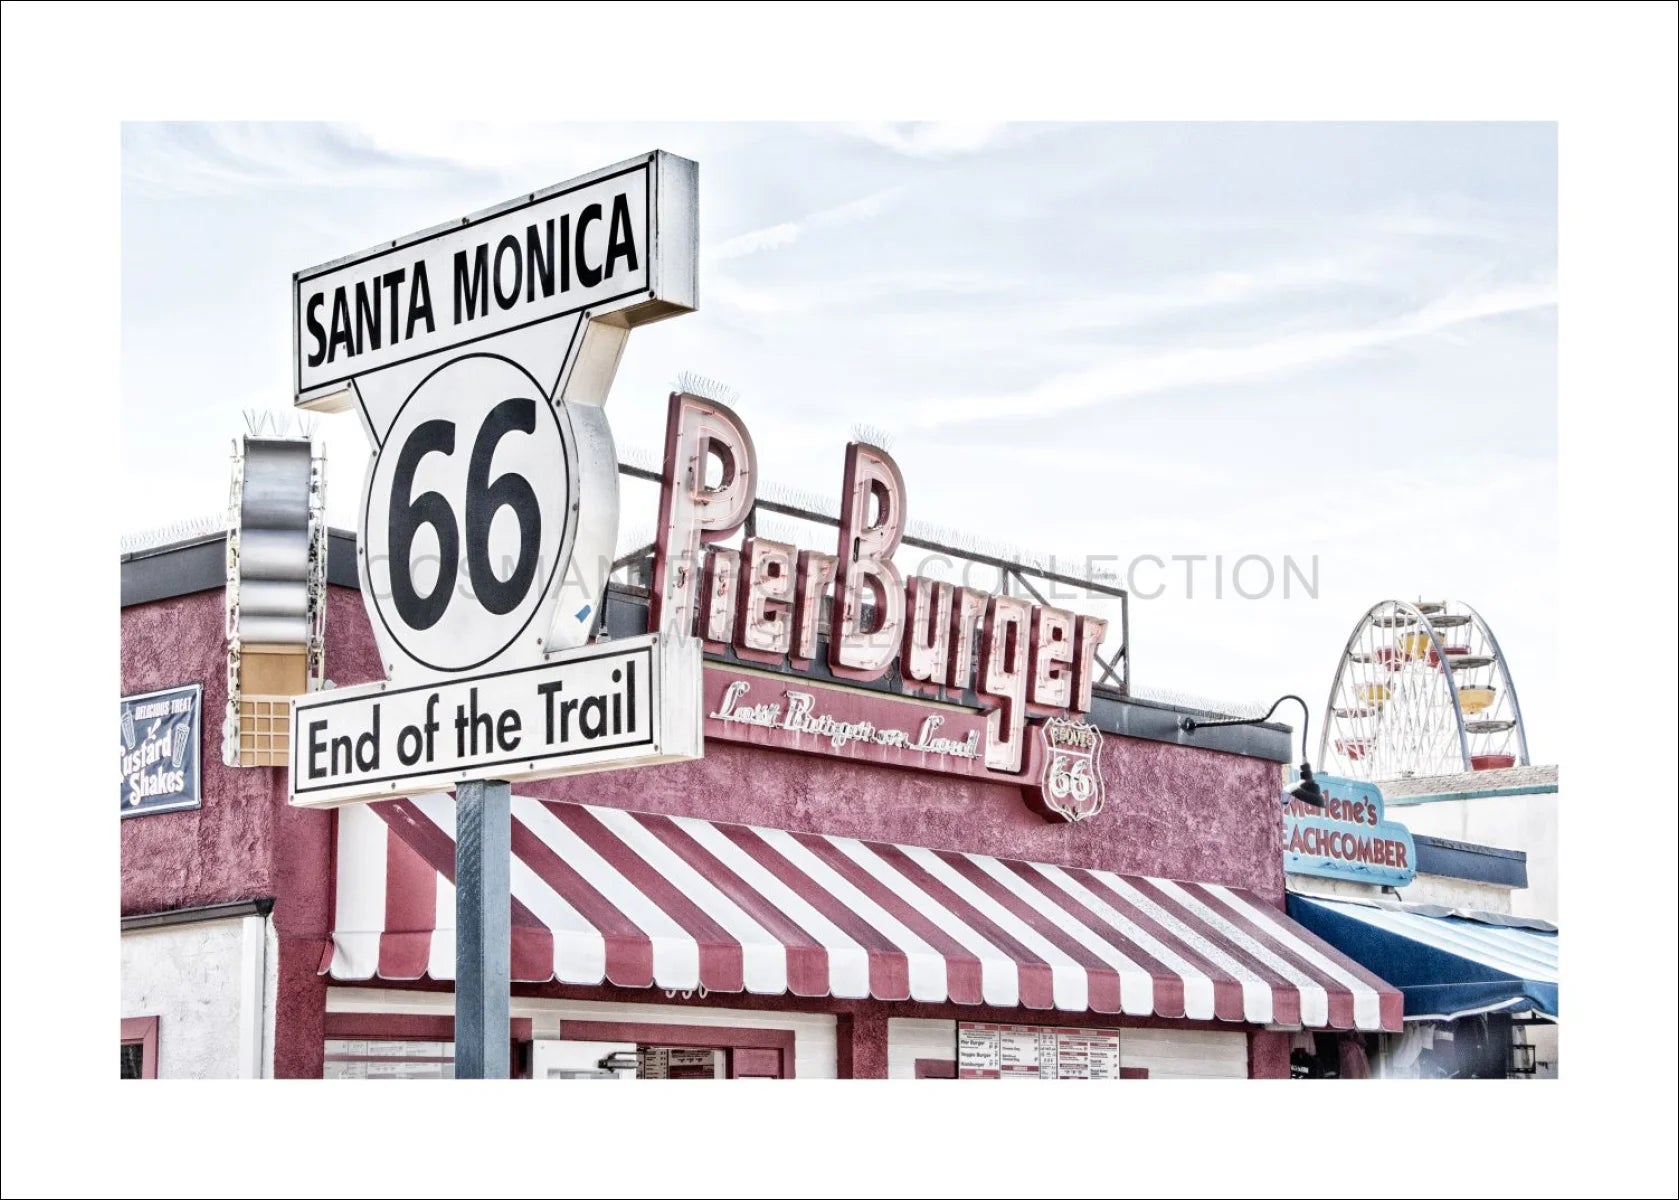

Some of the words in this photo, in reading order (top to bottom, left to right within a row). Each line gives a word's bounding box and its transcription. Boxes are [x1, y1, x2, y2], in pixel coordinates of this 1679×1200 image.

[306, 259, 436, 368] SANTA
[452, 192, 640, 327] MONICA
[388, 397, 542, 632] 66
[135, 700, 170, 720] DELICIOUS
[171, 697, 192, 714] TREAT
[307, 704, 381, 781] End
[396, 693, 440, 768] of
[454, 687, 522, 759] the
[537, 659, 637, 746] Trail
[129, 766, 184, 806] Shakes
[1050, 755, 1095, 802] 66
